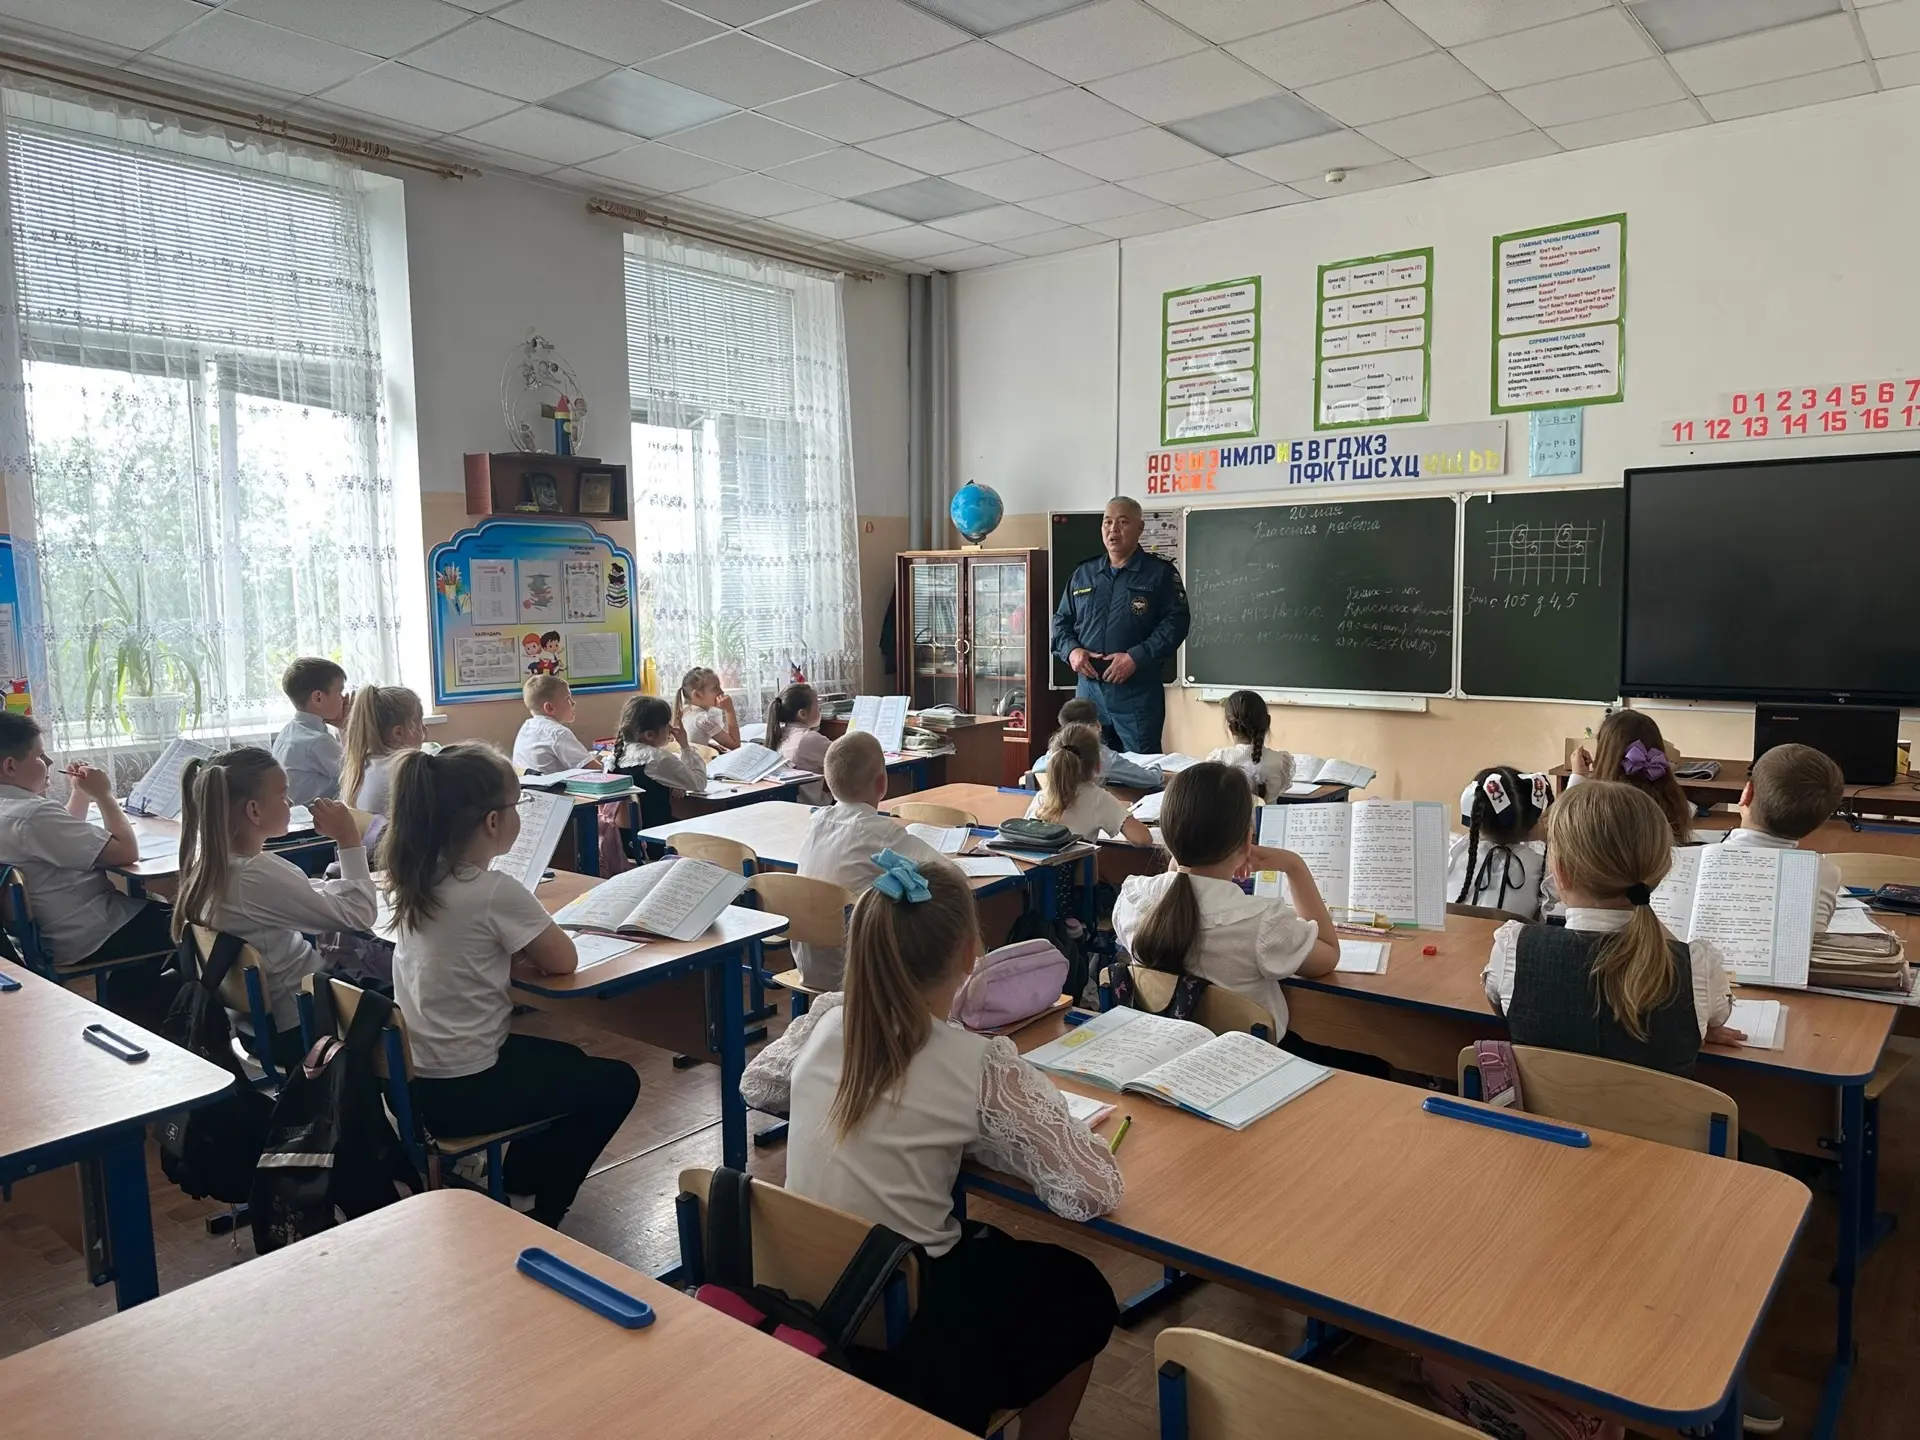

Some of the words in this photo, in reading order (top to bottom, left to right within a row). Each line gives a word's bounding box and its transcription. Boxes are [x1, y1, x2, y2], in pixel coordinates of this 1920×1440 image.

[1519, 240, 1542, 248] ГЛАВНЫЕ
[1562, 230, 1599, 240] ПРЕДЛОЖЕНИЯ
[1508, 274, 1552, 284] ВТОРОСТЕПЕННЫЕ
[1572, 264, 1610, 274] ПРЕДЛОЖЕНИЯ
[1507, 285, 1537, 294] Определение
[1507, 313, 1544, 322] Обстоятельство
[1529, 336, 1558, 345] СПРЯЖЕНИЕ
[1732, 394, 1747, 414] 0
[1754, 393, 1765, 412] 1
[1777, 391, 1792, 411] 2
[1802, 390, 1816, 409] 3
[1826, 387, 1841, 406] 4
[1851, 385, 1867, 405] 5
[1878, 383, 1894, 403] 6
[1905, 379, 1920, 401] 7
[1672, 422, 1694, 441] 11
[1705, 419, 1730, 439] 12
[1742, 417, 1768, 437] 13
[1781, 413, 1807, 434] 14
[1818, 411, 1846, 432] 15
[1860, 408, 1888, 429] 16
[1290, 506, 1307, 520] 20
[1310, 506, 1343, 518] мая
[1254, 521, 1317, 539] Классная
[1326, 516, 1380, 538] работа
[1516, 529, 1527, 543] 5
[1562, 529, 1573, 543] 5
[1504, 594, 1530, 609] 105
[1550, 592, 1578, 611] 4,5
